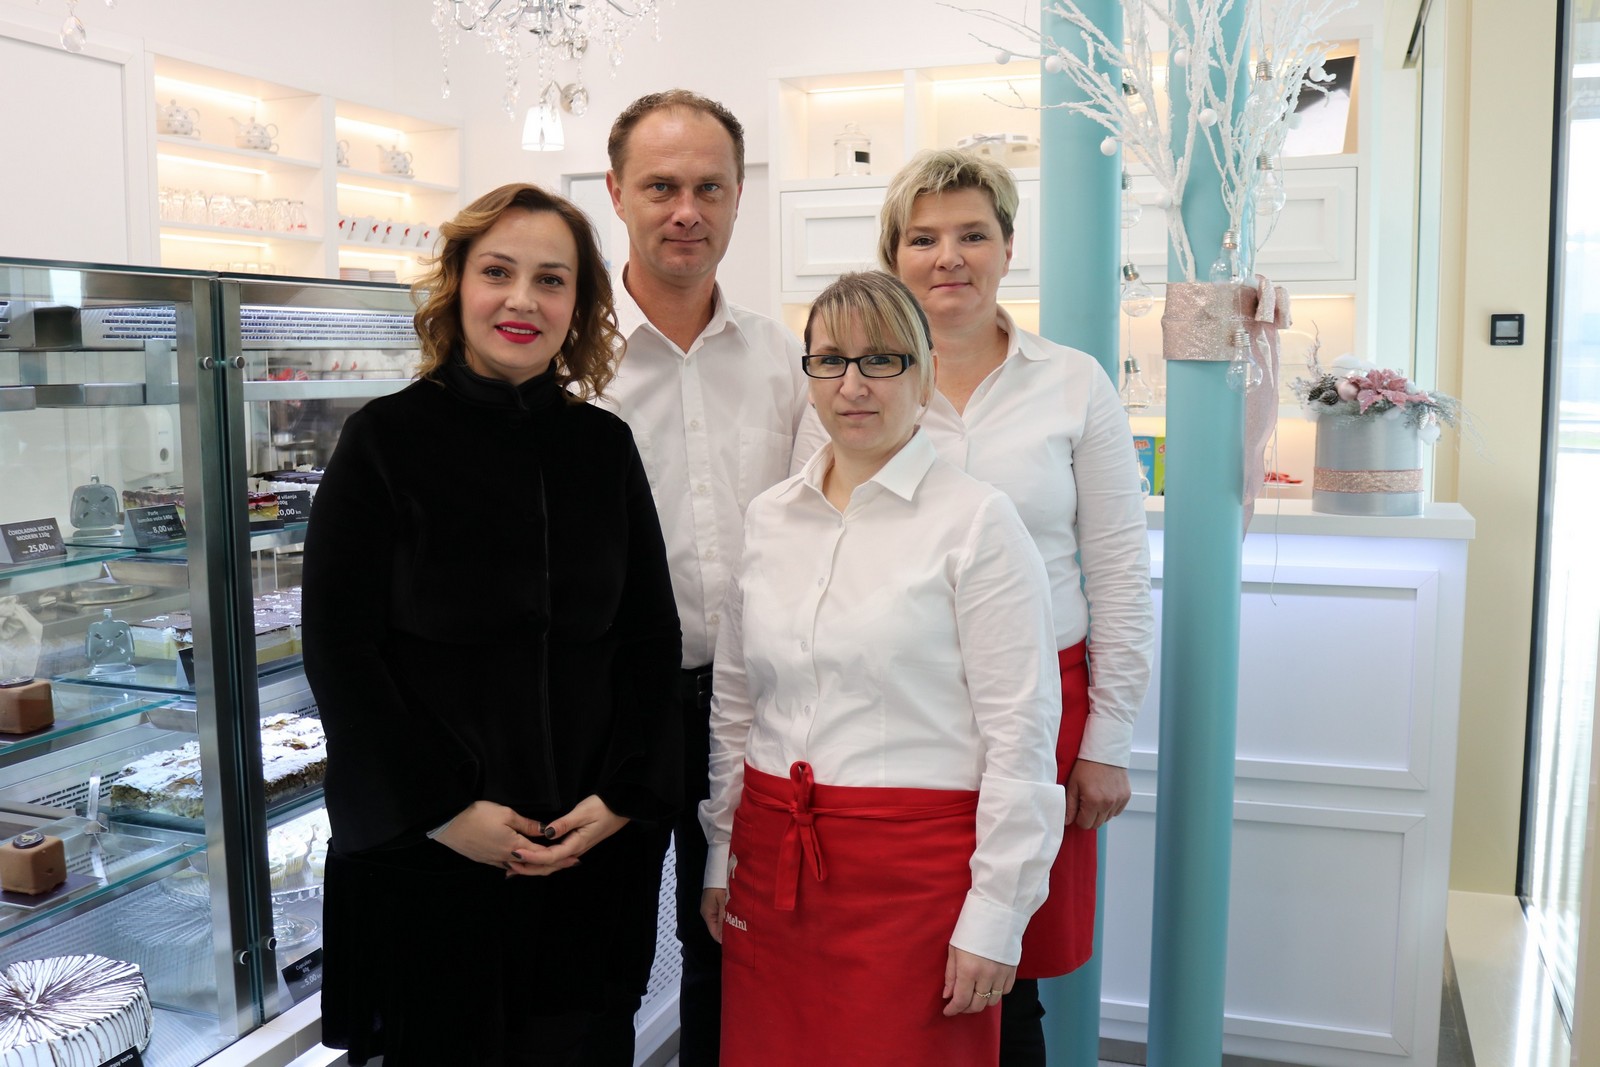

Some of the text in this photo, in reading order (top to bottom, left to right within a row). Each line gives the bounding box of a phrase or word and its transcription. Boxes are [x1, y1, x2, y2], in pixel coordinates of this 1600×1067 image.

[8, 528, 38, 536] ČOKOLADNA
[152, 525, 167, 534] 8,00
[28, 543, 49, 553] 25,00
[304, 974, 317, 986] 5,00
